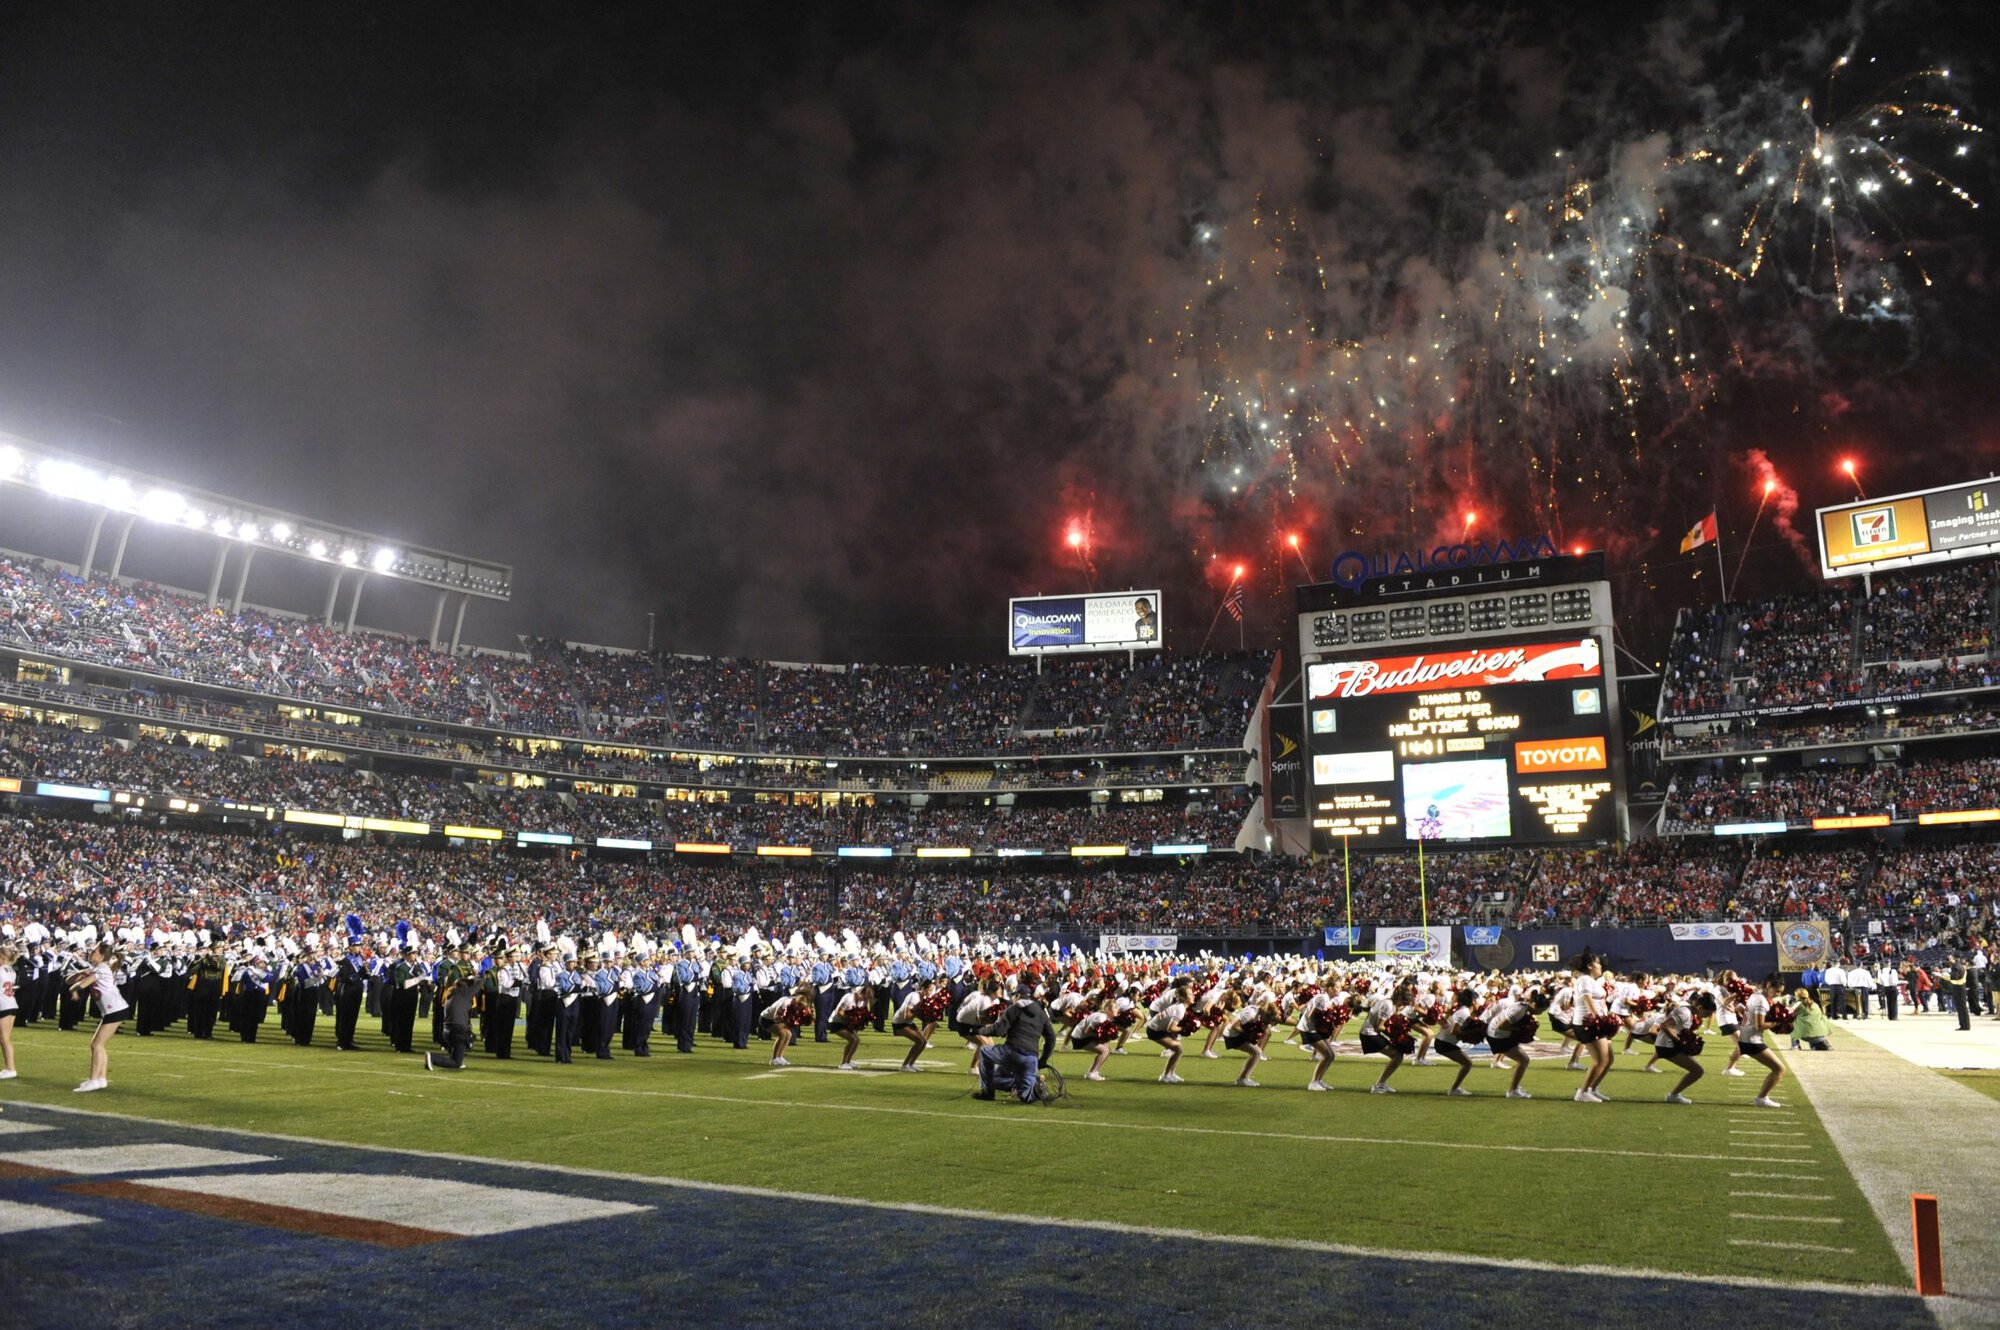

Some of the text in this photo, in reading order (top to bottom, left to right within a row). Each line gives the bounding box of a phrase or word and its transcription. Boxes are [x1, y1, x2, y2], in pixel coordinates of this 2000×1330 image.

[1930, 509, 2000, 528] Imaging Heal
[1939, 536, 1956, 544] Your
[1958, 531, 1988, 541] Partner
[1332, 535, 1558, 593] QUALCOMM
[1379, 566, 1540, 593] STADIUM
[1088, 600, 1133, 608] PALOMAR
[1088, 608, 1133, 617] POMERADO
[1016, 614, 1081, 629] QUALCOMM
[1335, 650, 1525, 698] Budweiser
[1418, 691, 1481, 706] THANKS TO
[1409, 703, 1492, 721] DR PEPPER
[1694, 713, 1719, 721] CONDUCT
[1834, 699, 1860, 707] OCATION
[1389, 715, 1520, 737] HALFTIME SHOW
[1626, 739, 1662, 752] Sprint
[1519, 746, 1601, 766] TOYOTA
[1271, 761, 1301, 773] Sprint
[1393, 932, 1418, 942] PACIFIC
[1741, 924, 1764, 942] N
[1106, 937, 1121, 952] A
[1535, 945, 1556, 961] 25
